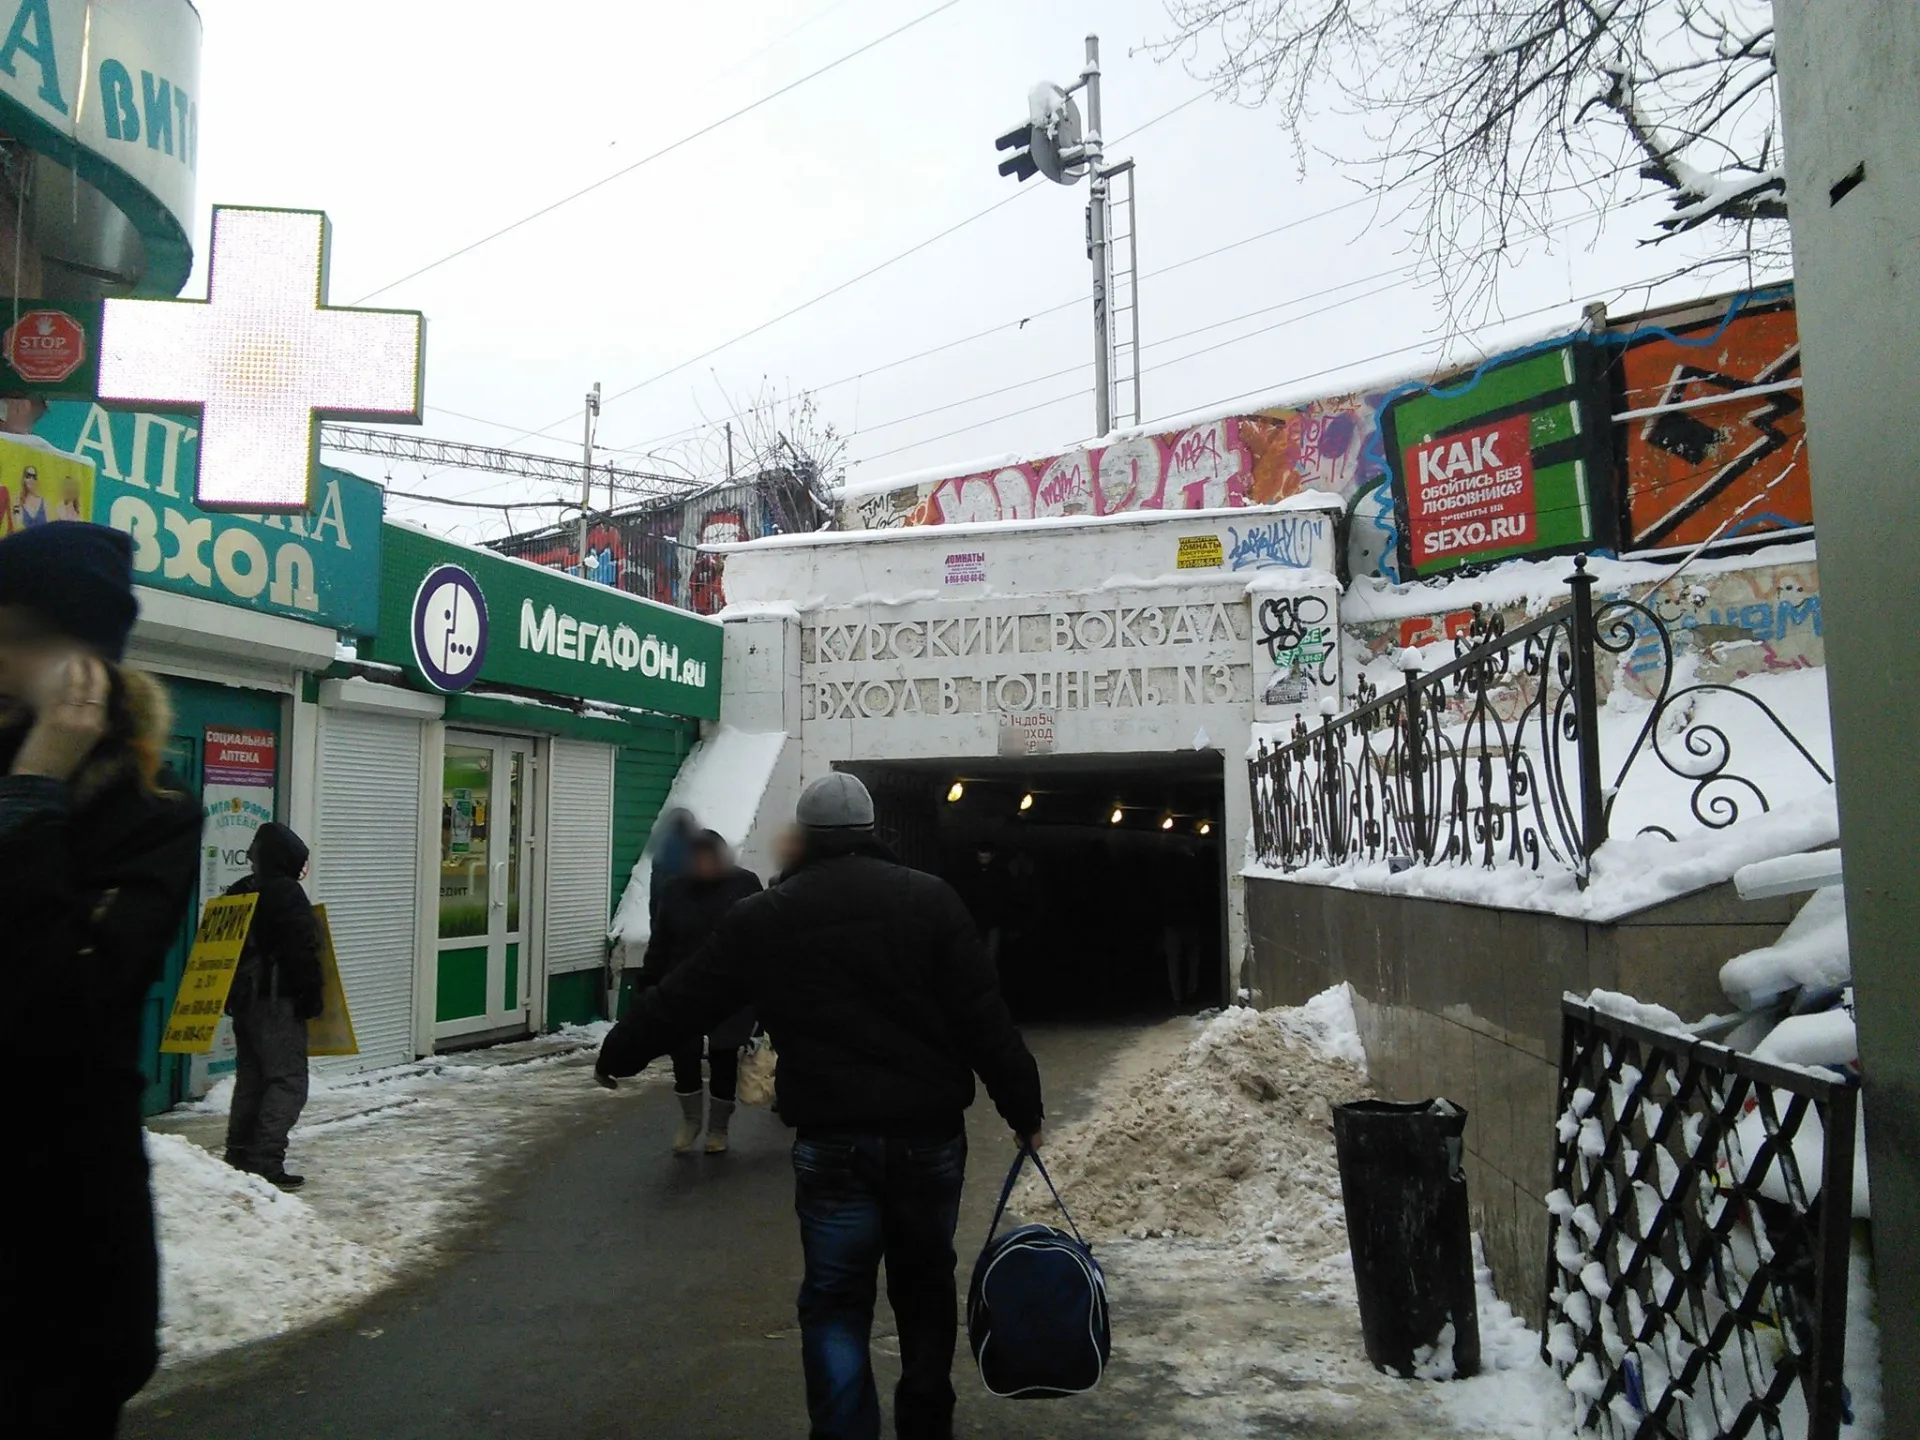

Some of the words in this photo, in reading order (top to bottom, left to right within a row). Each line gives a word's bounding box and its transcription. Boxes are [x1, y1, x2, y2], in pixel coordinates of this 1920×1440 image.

[20, 336, 66, 349] STOP
[1418, 431, 1503, 485] КАК
[1420, 474, 1494, 501] ОБОЙТИСЬ
[1495, 465, 1523, 484] БЕЗ
[1421, 480, 1523, 515] ЛЮБОВНИКА?
[1489, 503, 1504, 514] на
[1423, 514, 1526, 554] SEXO.RU
[109, 495, 319, 612] ВХОД
[815, 616, 1021, 664] КУРСКИЙ
[1050, 602, 1239, 651] ВОКЗАЛ
[815, 678, 923, 720] ВХОД
[938, 677, 961, 714] В
[972, 667, 1161, 713] ТОННЕЛЬ
[206, 730, 274, 748] СОЦИАЛЬНАЯ
[219, 750, 260, 764] АПТЕКА
